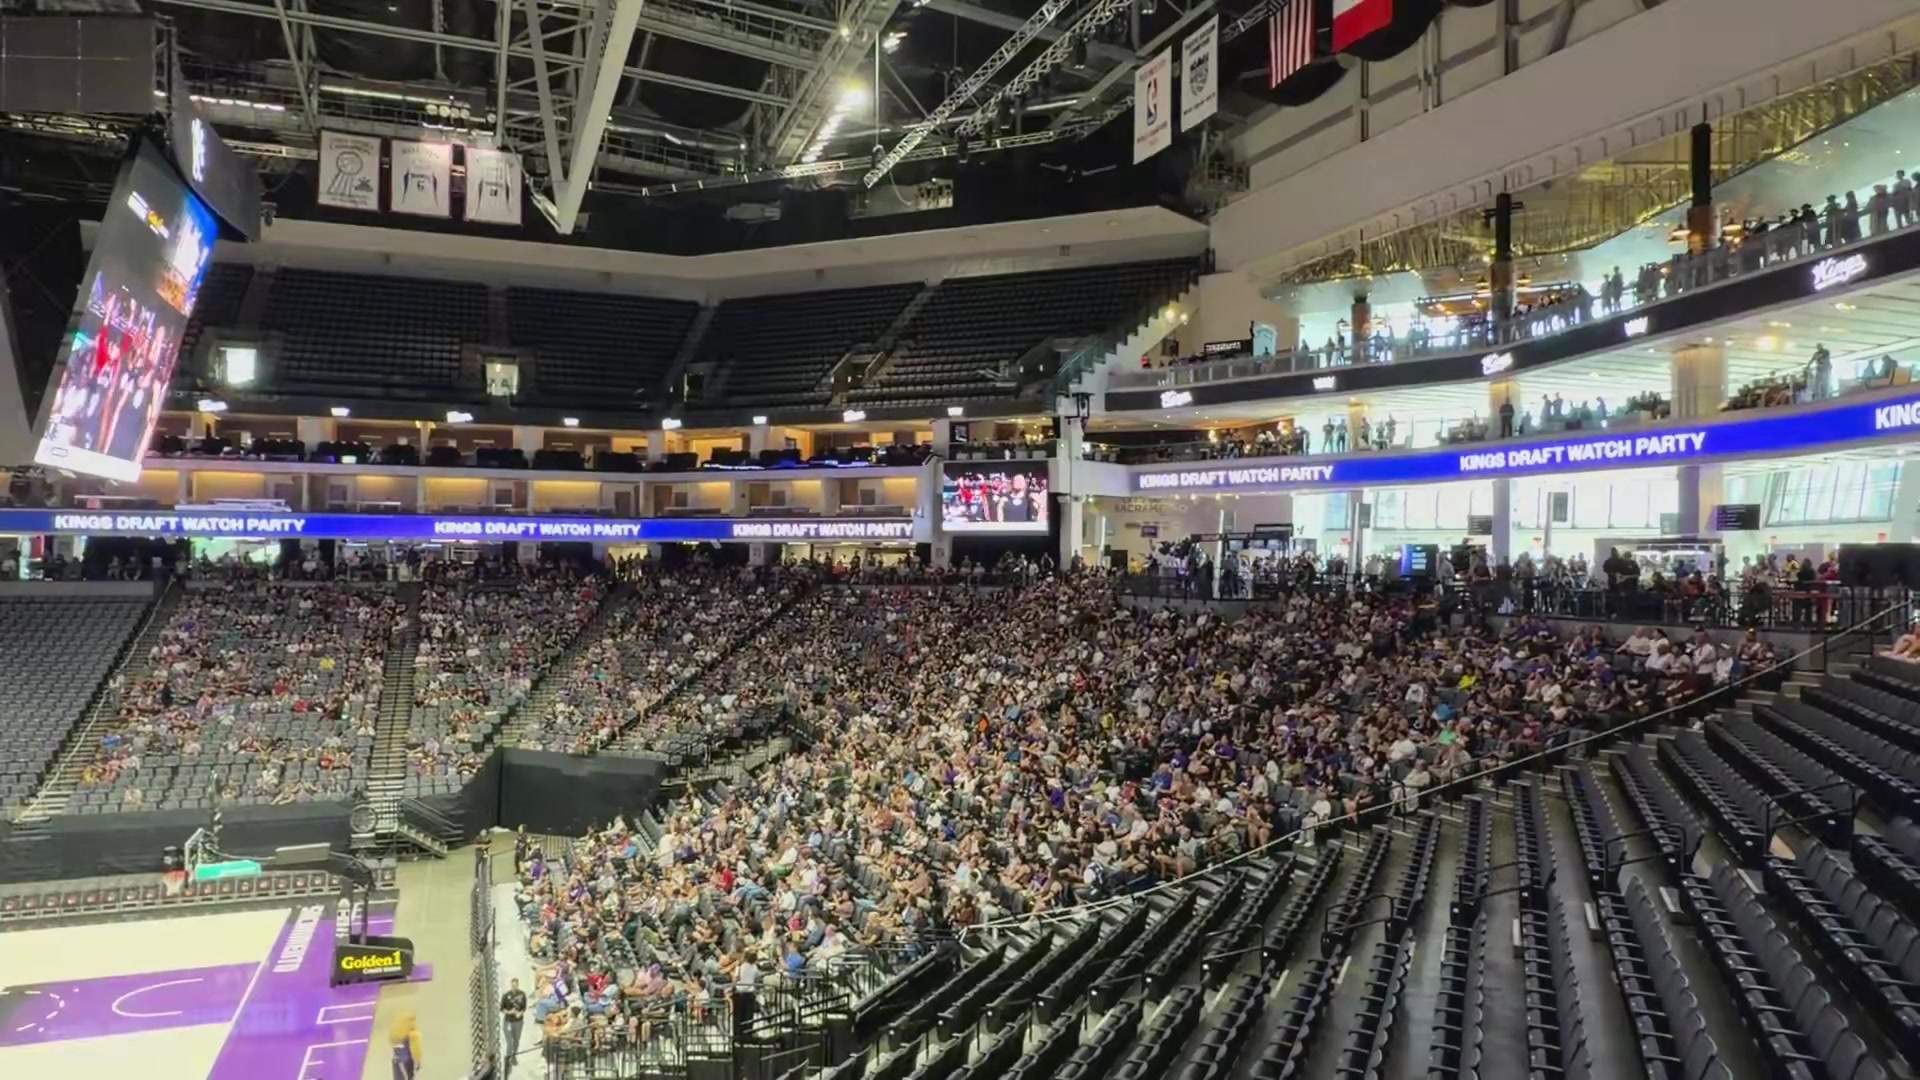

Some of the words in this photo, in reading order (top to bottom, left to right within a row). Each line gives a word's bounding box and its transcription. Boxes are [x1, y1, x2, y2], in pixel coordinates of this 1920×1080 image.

[1460, 453, 1505, 471] KINGS
[1509, 446, 1565, 468] DRAFT
[1567, 439, 1632, 461] WATCH
[1636, 432, 1706, 455] PARTY
[1140, 473, 1179, 488] KINGS
[1181, 471, 1226, 486] DRAFT
[1229, 468, 1279, 484] WATCH
[1281, 466, 1333, 481] PARTY
[55, 515, 113, 530] KINGS
[117, 516, 179, 530] DRAFT
[182, 516, 244, 531] WATCH
[247, 518, 305, 532] PARTY
[435, 521, 482, 534] KINGS
[485, 522, 537, 535] DRAFT
[540, 522, 591, 535] WATCH
[594, 523, 640, 536] PARTY
[733, 523, 771, 537] KINGS
[773, 523, 817, 537] DRAFT
[819, 523, 865, 537] WATCH
[867, 523, 913, 537] PARTY
